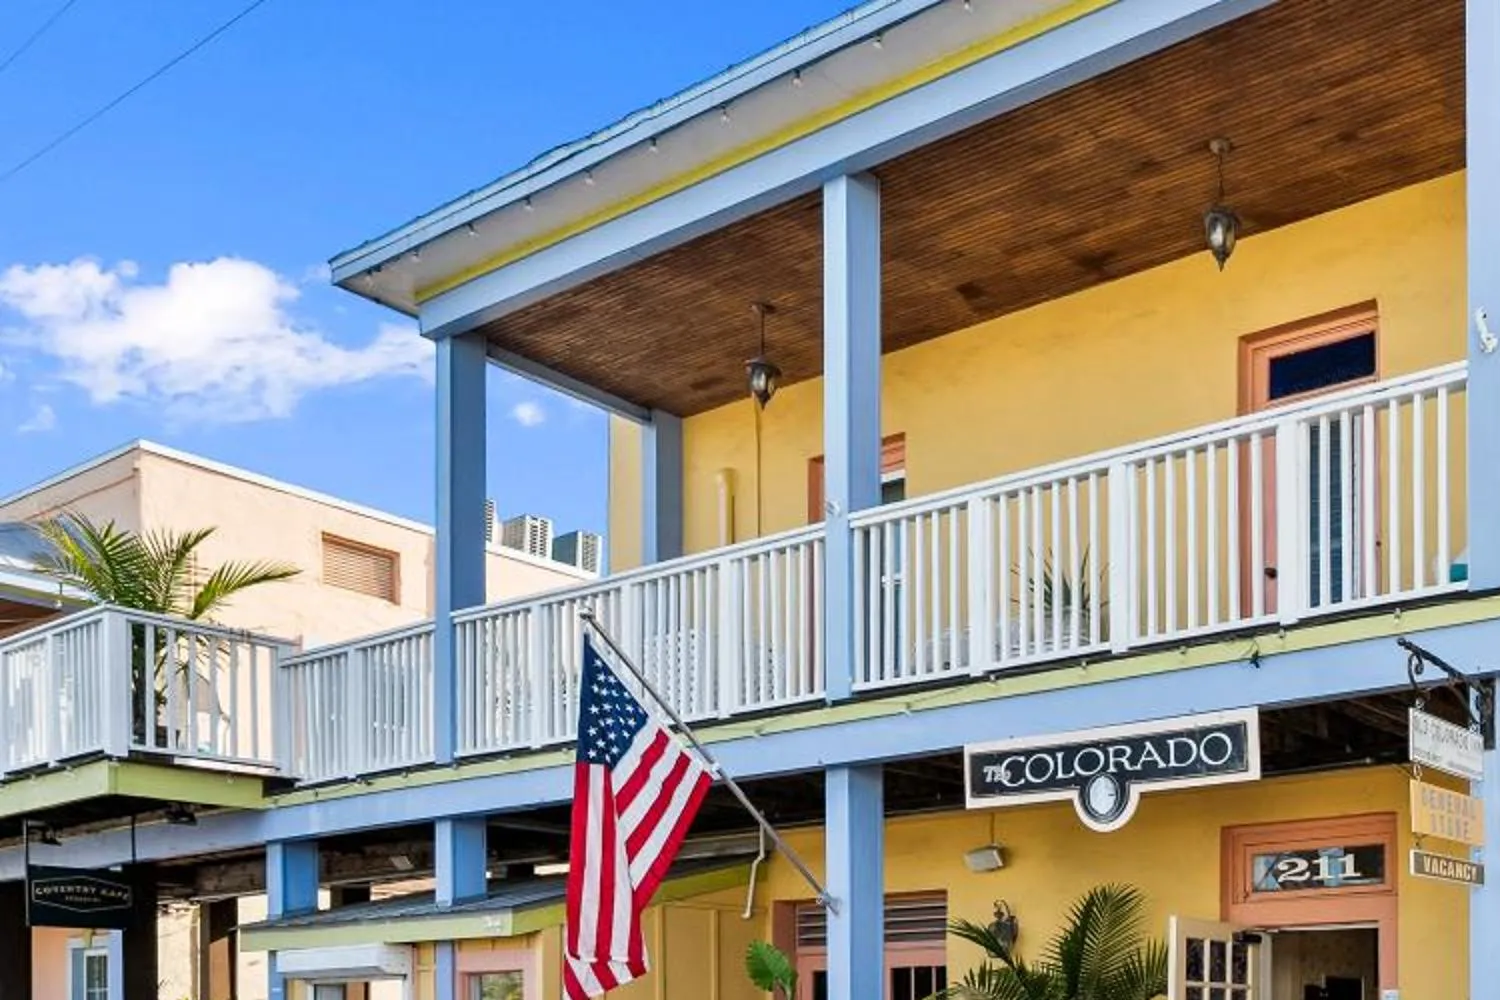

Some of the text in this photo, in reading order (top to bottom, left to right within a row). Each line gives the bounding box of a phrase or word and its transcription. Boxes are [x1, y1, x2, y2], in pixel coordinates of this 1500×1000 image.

[1001, 732, 1233, 787] COLORADO
[1277, 853, 1362, 883] 211
[1423, 855, 1478, 881] VACANCY
